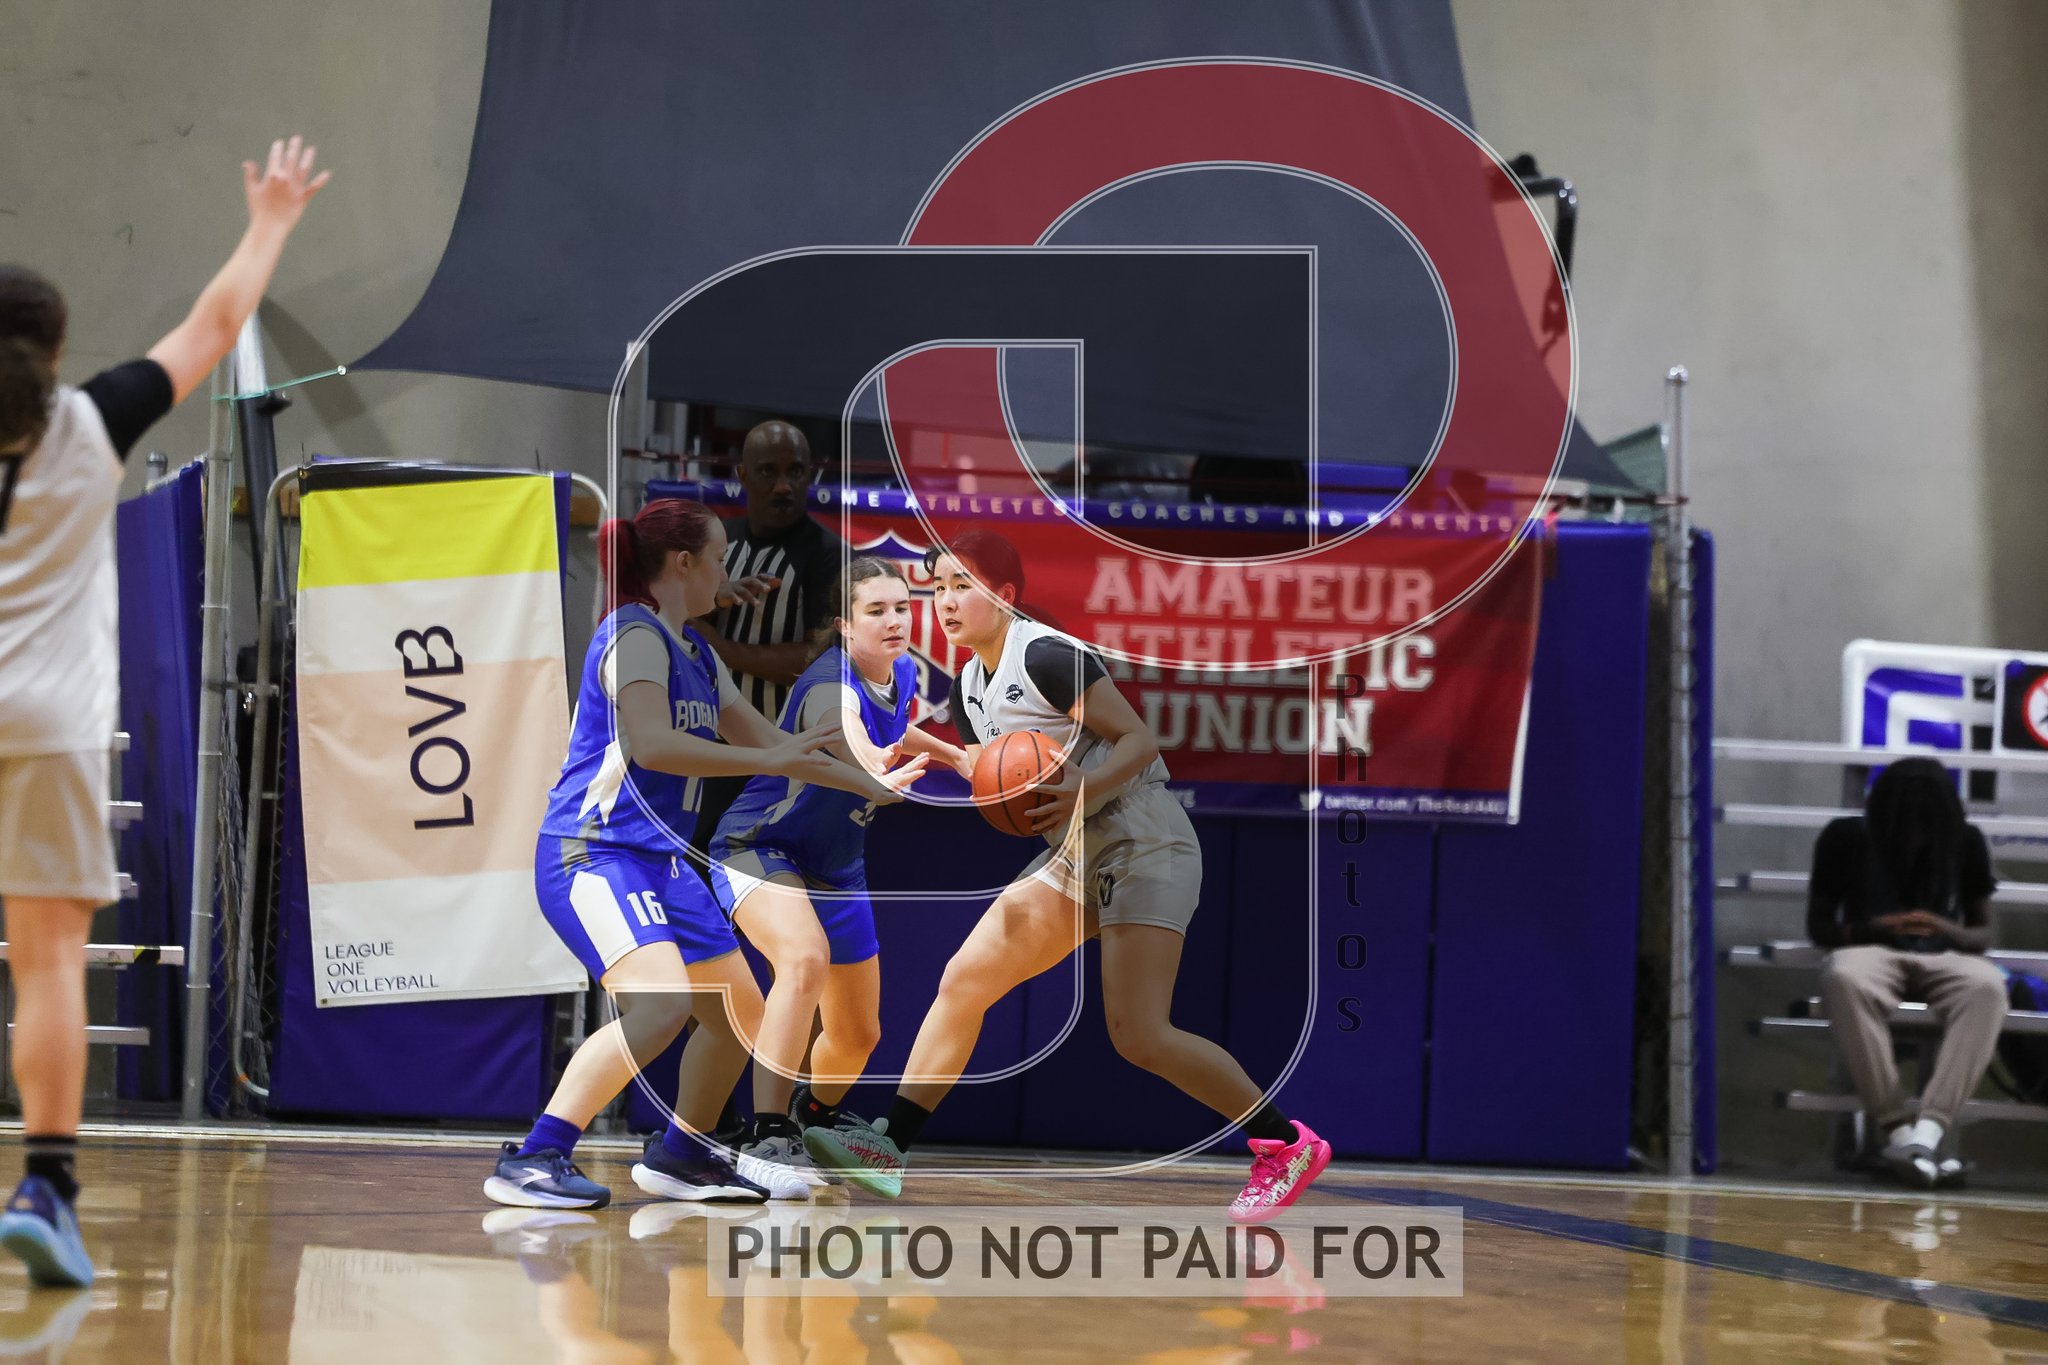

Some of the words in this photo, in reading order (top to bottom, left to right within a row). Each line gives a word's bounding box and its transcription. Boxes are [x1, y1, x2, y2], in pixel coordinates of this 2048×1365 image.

[724, 482, 880, 508] WOME
[905, 493, 1067, 517] ATHLETES
[1108, 501, 1259, 524] COACHES
[1282, 509, 1344, 527] AND
[1084, 556, 1436, 626] AMATEUR
[1093, 622, 1437, 692] ATHLETIC
[395, 624, 475, 831] LOVB
[1139, 690, 1376, 757] UNION
[626, 890, 669, 928] 16
[325, 942, 395, 960] LEAGUE
[326, 961, 366, 978] ONE
[327, 974, 440, 995] VOLLEYBALL
